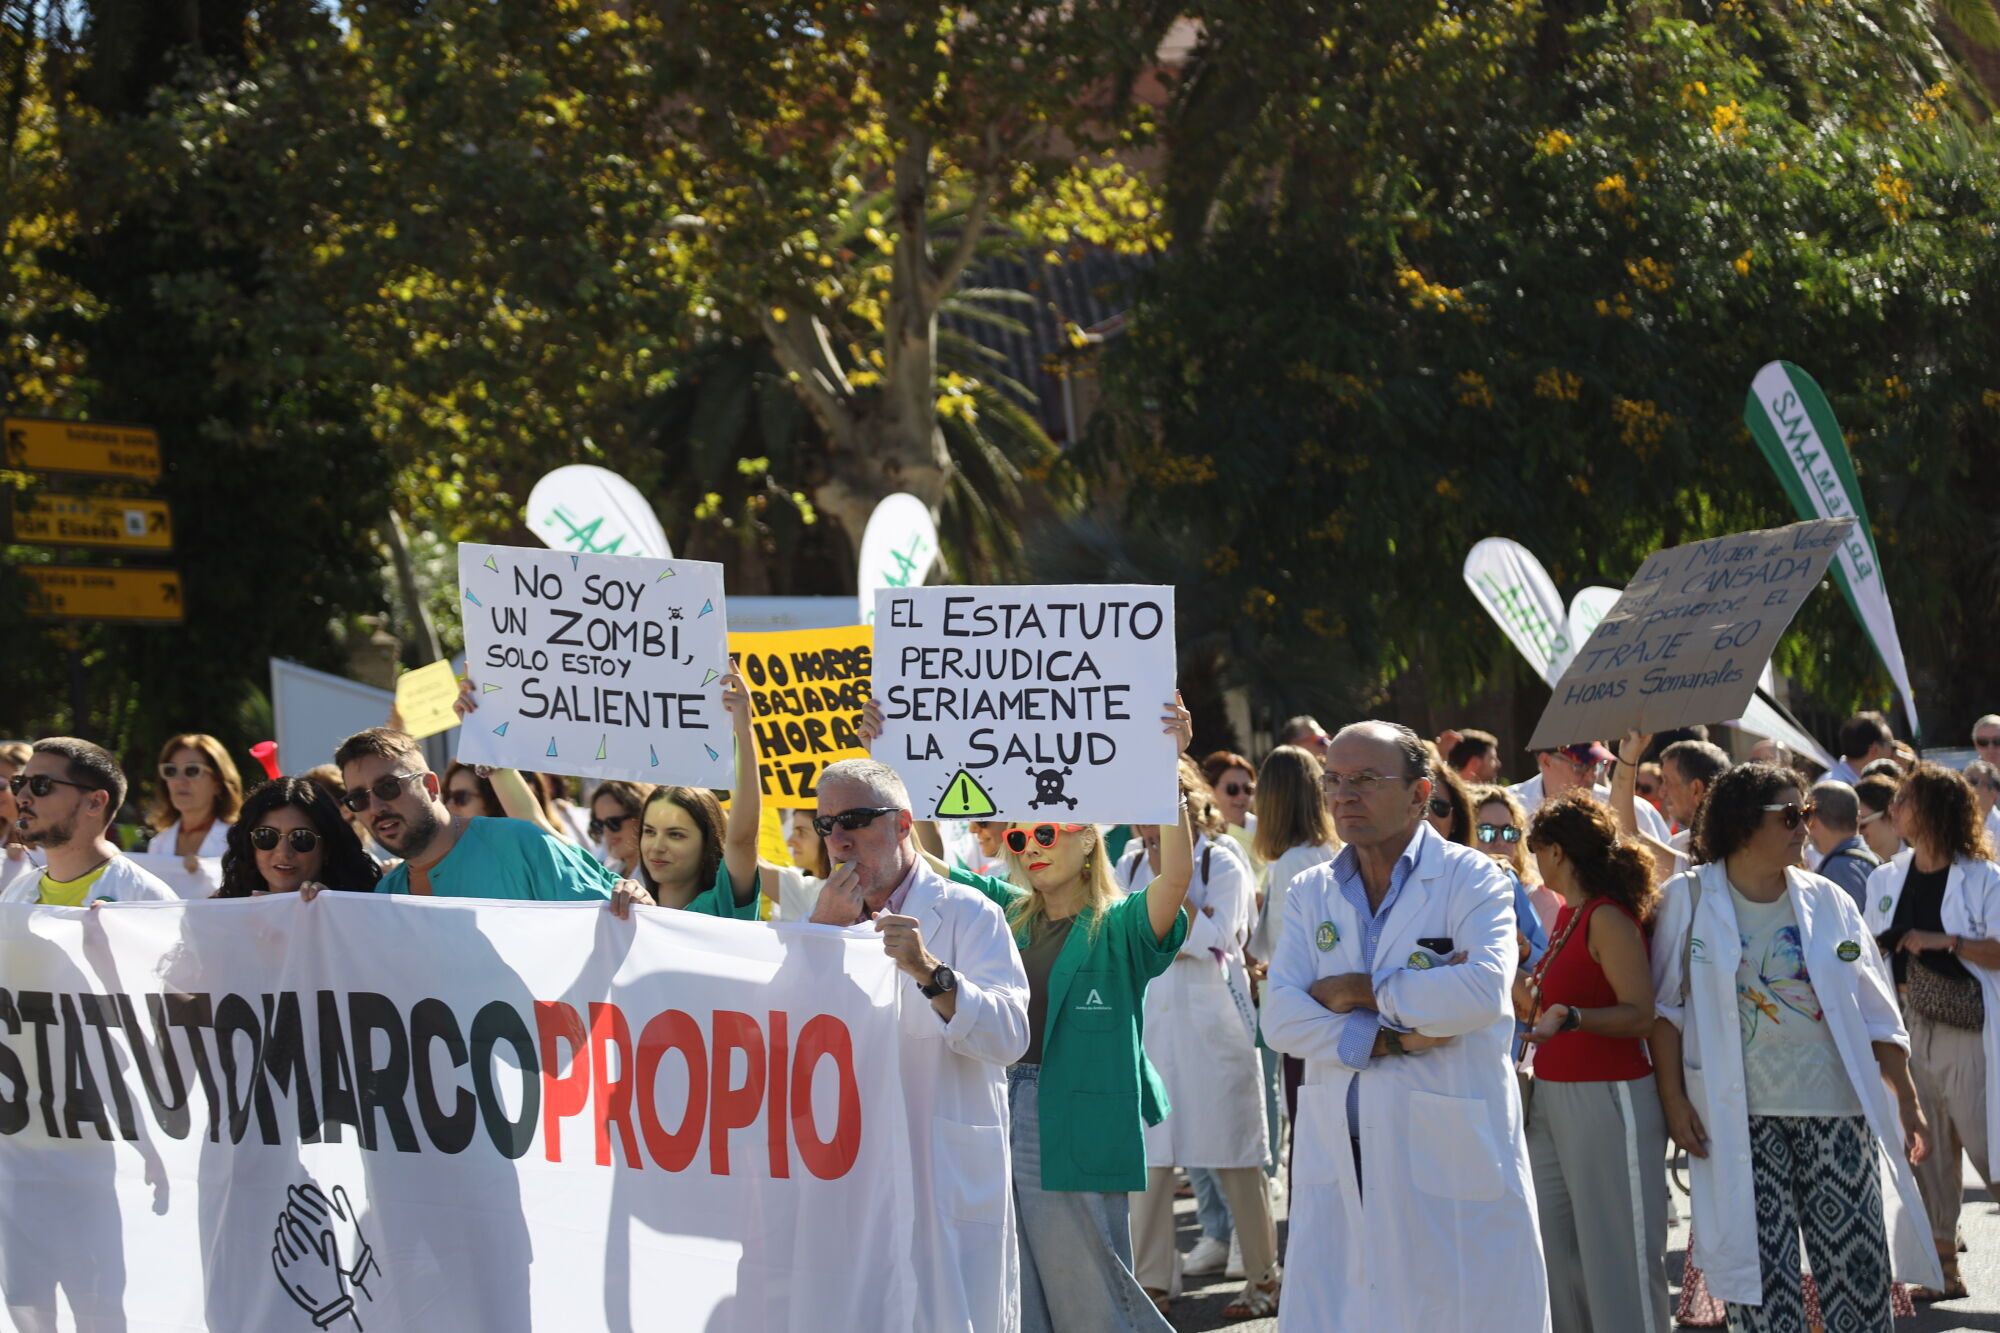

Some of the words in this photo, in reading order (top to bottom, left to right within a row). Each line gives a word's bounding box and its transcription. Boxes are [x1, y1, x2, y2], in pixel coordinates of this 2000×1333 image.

[1772, 390, 1820, 473] SMA
[514, 565, 562, 600] NO
[582, 574, 645, 612] SOY
[1681, 556, 1811, 594] CANSADA
[891, 598, 923, 628] EL
[943, 596, 1163, 640] ESTATUTO
[1763, 589, 1788, 606] EL
[491, 607, 526, 636] UN
[485, 644, 548, 671] SOLO
[562, 653, 631, 678] ESTOY
[901, 646, 1101, 682] PERJUDICA
[1586, 632, 1692, 672] TRAJE
[1714, 619, 1760, 651] 60
[1564, 679, 1628, 704] HORAS
[1639, 658, 1744, 694] Semanales
[518, 677, 709, 730] SALIENTE
[887, 684, 1130, 721] SERIAMENTE
[906, 733, 944, 761] LA
[965, 728, 1116, 769] SALUD
